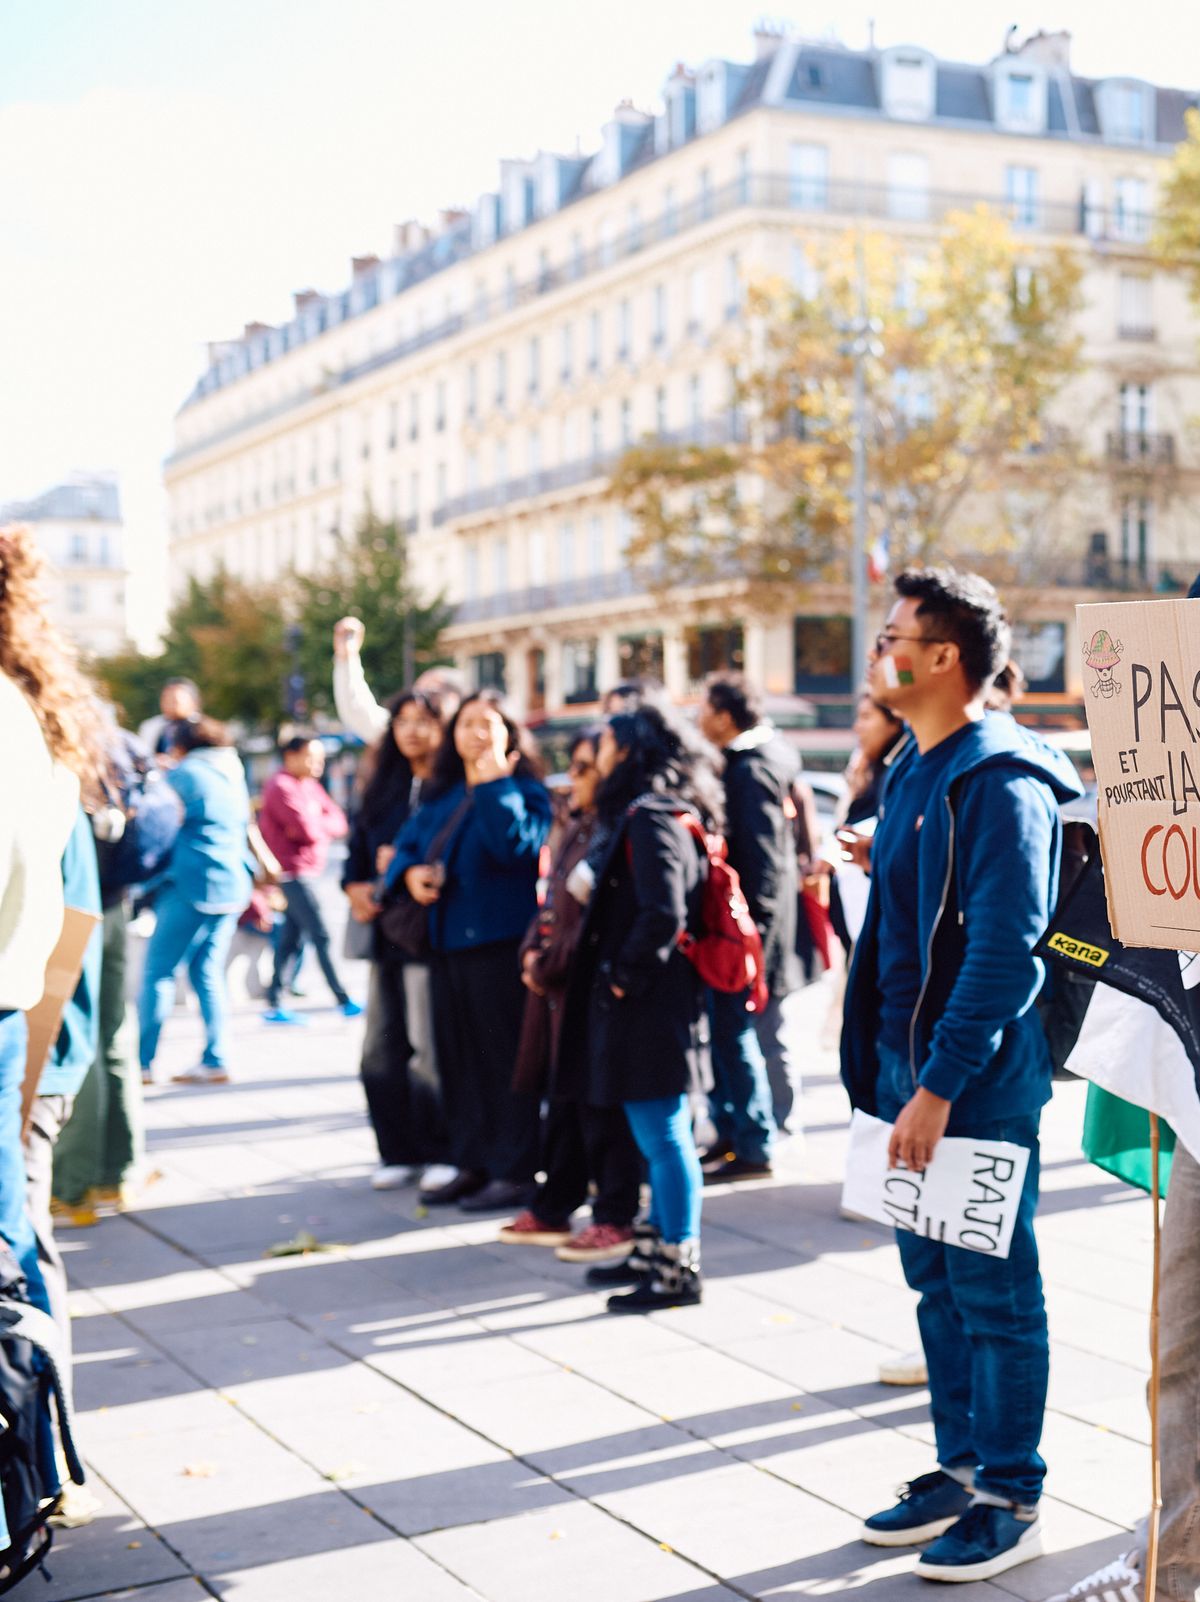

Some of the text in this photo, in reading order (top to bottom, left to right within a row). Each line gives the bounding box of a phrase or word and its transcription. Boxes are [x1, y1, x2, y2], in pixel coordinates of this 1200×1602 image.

[1119, 749, 1138, 774] ET
[1105, 775, 1168, 807] POURTANT
[1055, 937, 1102, 961] kana
[959, 1152, 1015, 1252] RAJO
